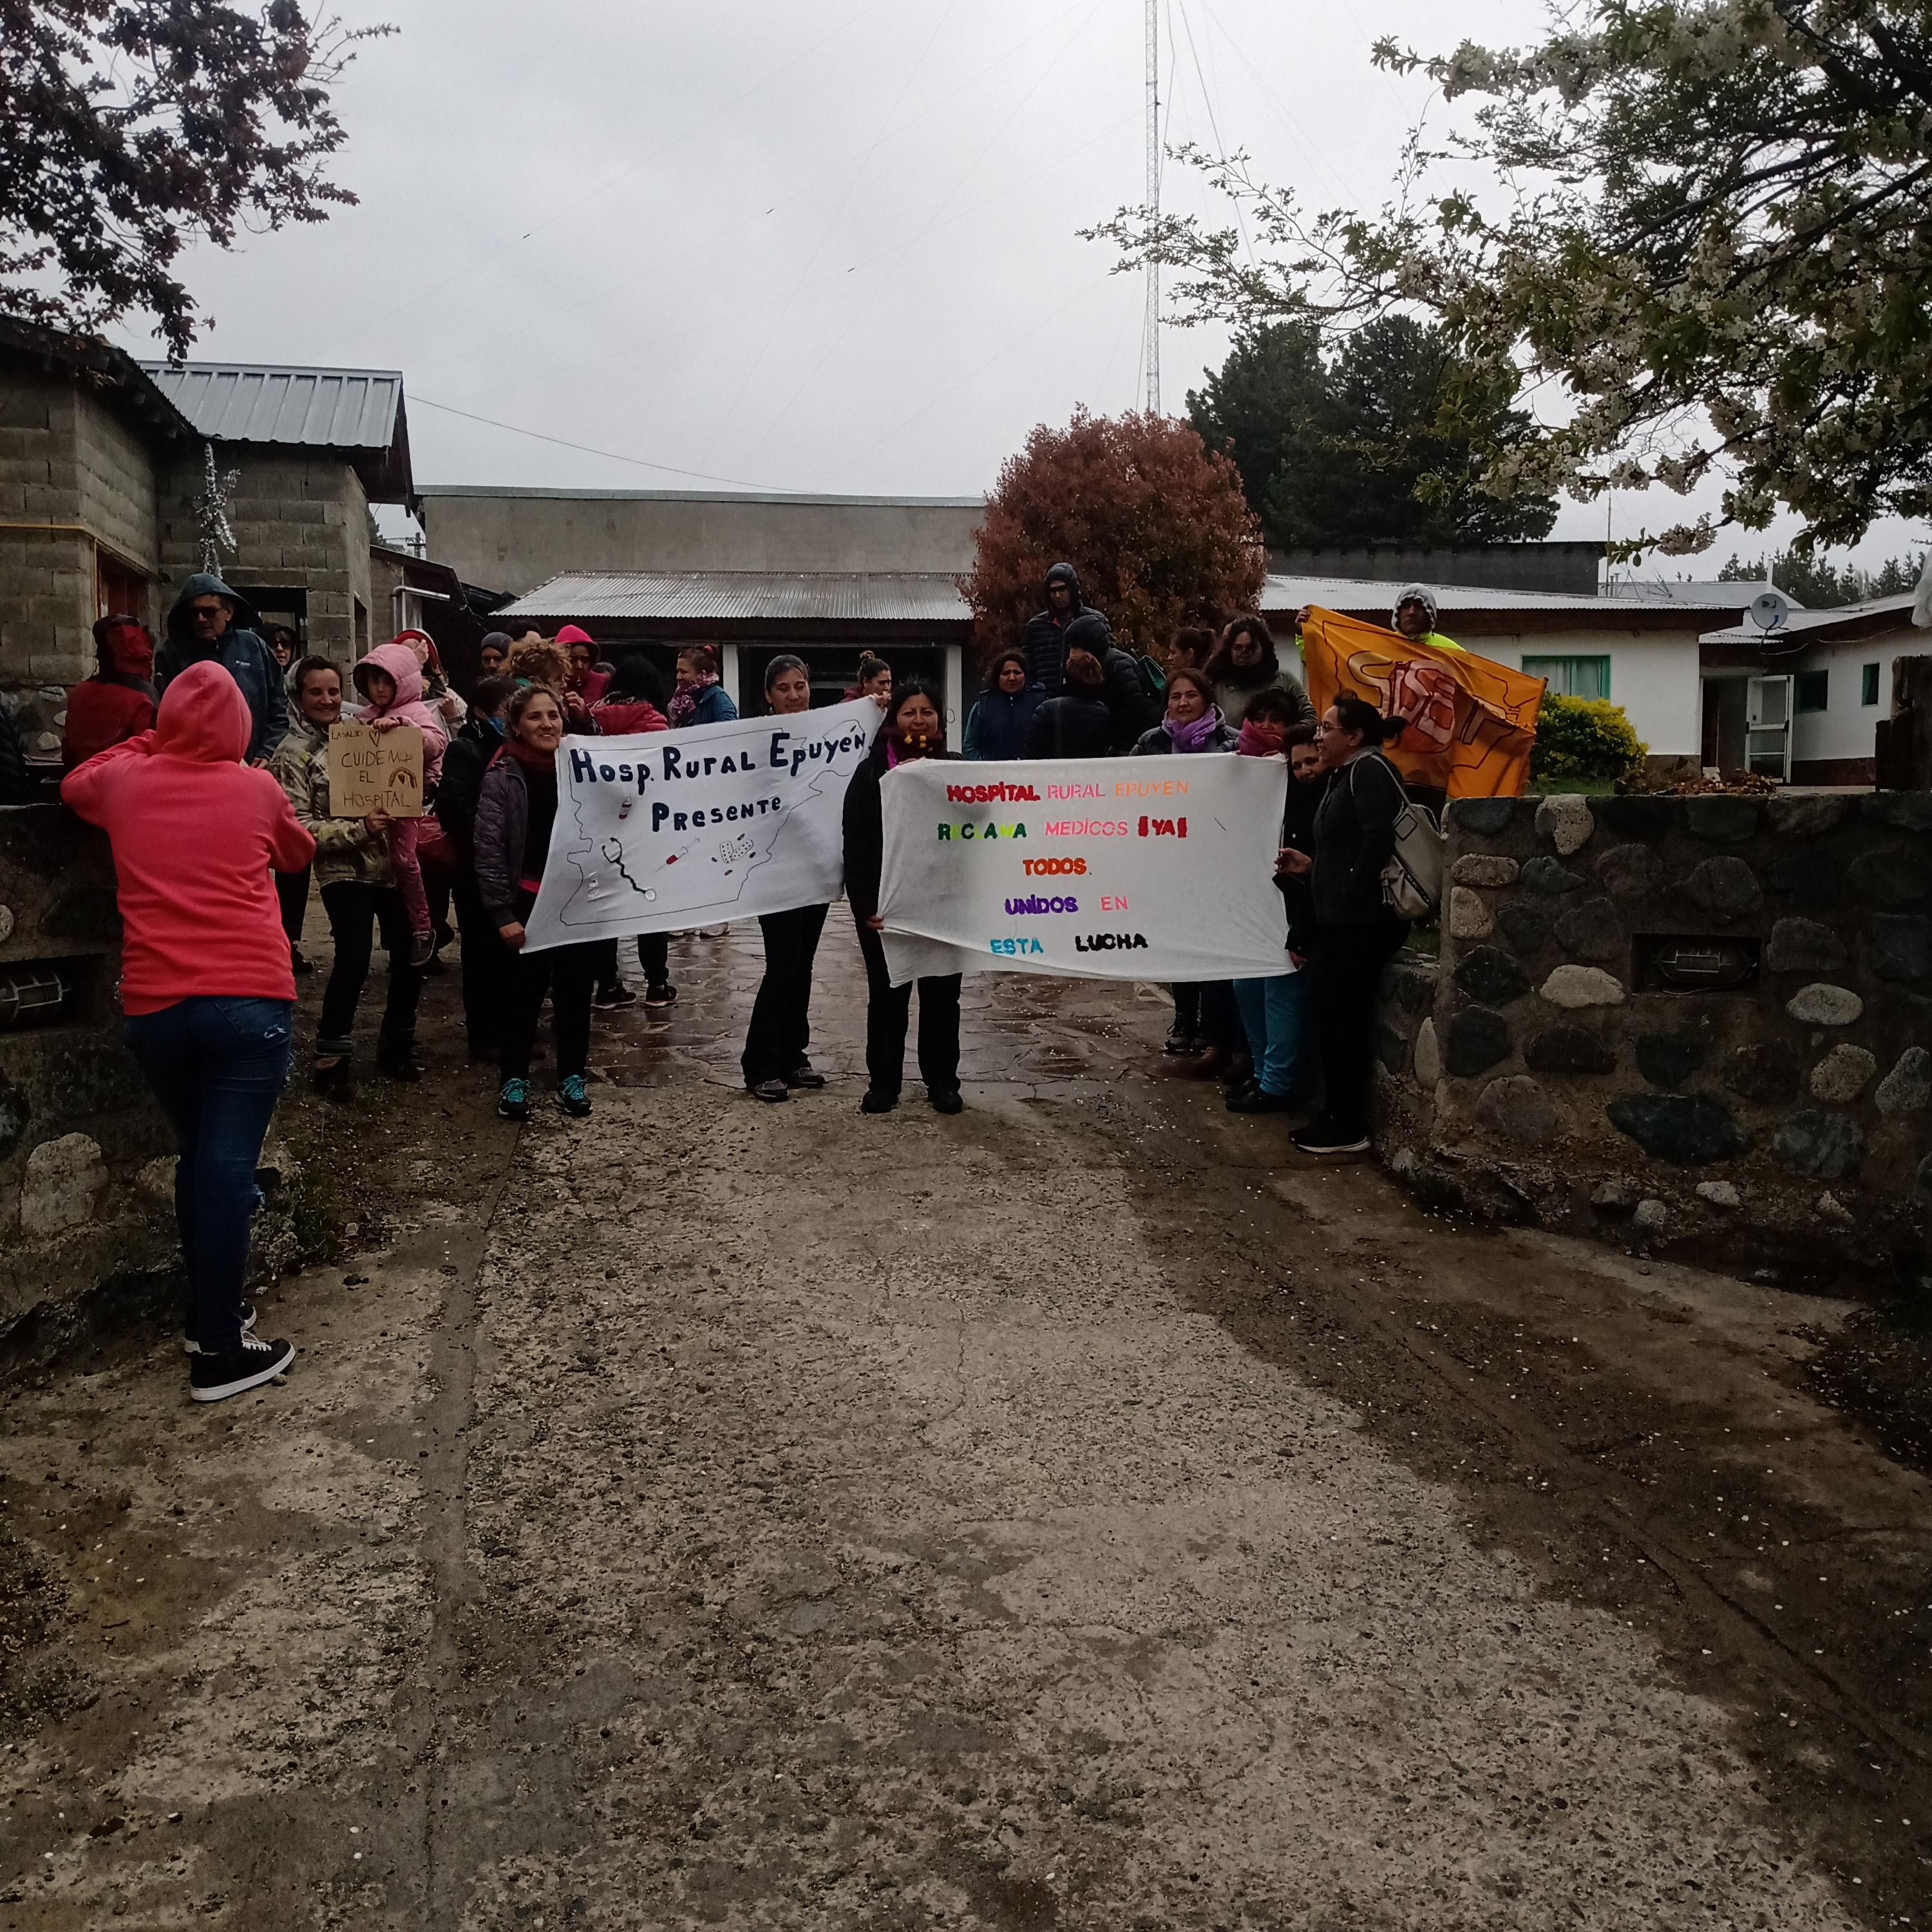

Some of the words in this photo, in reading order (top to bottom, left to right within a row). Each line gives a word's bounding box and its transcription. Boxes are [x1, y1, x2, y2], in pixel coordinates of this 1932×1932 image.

[359, 770, 374, 783] EL
[343, 790, 411, 808] HOSPITAL
[947, 781, 1041, 804] HOSPITAL
[1047, 783, 1105, 800] RURAL
[1115, 781, 1189, 797] EPUYEN
[938, 823, 1027, 840] RECLAMA
[1045, 818, 1129, 837] MEDICOS
[1005, 895, 1079, 915] UNIDOS
[1101, 896, 1129, 912] EN
[990, 938, 1044, 956] ESTA
[1075, 934, 1148, 952] LUCHA
